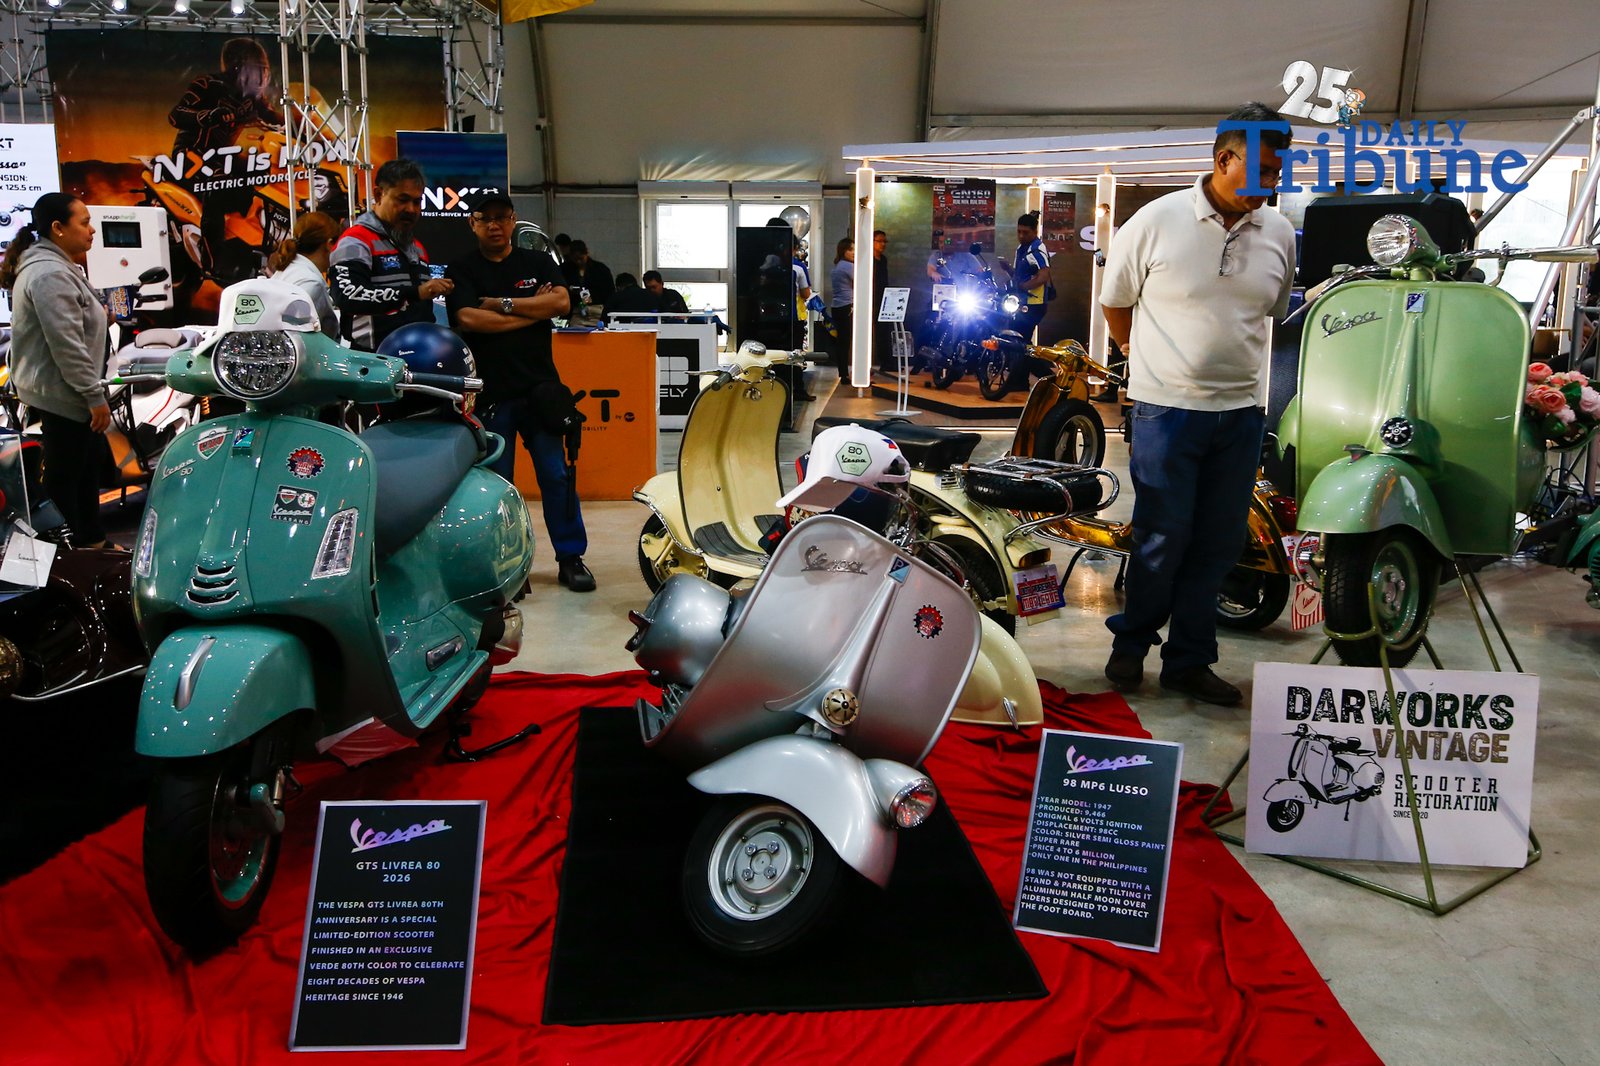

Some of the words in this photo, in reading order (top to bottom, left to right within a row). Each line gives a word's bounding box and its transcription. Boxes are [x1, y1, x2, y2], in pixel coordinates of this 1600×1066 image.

[153, 145, 242, 184] NXT
[247, 146, 271, 172] is
[193, 177, 244, 193] ELECTRIC
[241, 298, 256, 306] 80
[1321, 311, 1384, 339] Vespa
[848, 446, 863, 455] 80
[842, 454, 867, 463] Vespa
[162, 458, 197, 479] Vespa
[272, 503, 313, 516] Vespa
[1285, 686, 1514, 731] DARWORKS
[1372, 728, 1510, 764] VINTAGE
[1066, 745, 1153, 774] Vespa
[1063, 778, 1077, 788] 98
[1080, 780, 1106, 791] MP6
[1109, 784, 1149, 796] LUSSO
[1394, 774, 1498, 794] SCOOTER
[1061, 799, 1091, 808] MODEL:
[1393, 792, 1500, 812] RESTORATION
[1393, 810, 1411, 819] SINCE
[1080, 817, 1104, 826] VOLTS
[1106, 821, 1143, 831] IGNITION
[350, 818, 453, 853] Vespa
[1098, 828, 1119, 836] 98CC
[1060, 839, 1080, 847] RARE
[1065, 831, 1091, 841] SILVER
[1092, 835, 1112, 843] SEMI
[1113, 838, 1140, 847] GLOSS
[1141, 841, 1166, 850] PAINT
[1063, 847, 1073, 855] TO
[1082, 850, 1115, 860] MILLION
[356, 862, 378, 870] GTS
[382, 861, 422, 870] LIVREA
[427, 861, 440, 870] 80
[1053, 854, 1070, 863] ONE
[1082, 858, 1097, 866] THE
[1099, 861, 1148, 873] PHILIPPINES
[383, 874, 411, 882] 2026
[1026, 866, 1036, 875] 98
[1038, 869, 1055, 878] WAS
[1057, 872, 1075, 880] NOT
[1076, 875, 1119, 886] EQUIPPED
[1120, 881, 1142, 890] WITH
[1025, 875, 1052, 886] STAND
[1061, 881, 1094, 892] PARKED
[1096, 886, 1107, 894] BY
[1109, 888, 1141, 899] TILTING
[1023, 883, 1068, 897] ALUMINUM
[1070, 892, 1092, 901] HALF
[1094, 895, 1121, 905] MOON
[1123, 899, 1146, 909] OVER
[367, 901, 384, 909] GTS
[1021, 901, 1036, 910] THE
[1038, 904, 1061, 914] FOOT
[1062, 908, 1094, 919] BOARD.
[1022, 892, 1051, 903] RIDERS
[1053, 898, 1095, 910] DESIGNED
[1097, 904, 1108, 912] TO
[1110, 906, 1149, 918] PROTECT
[316, 916, 379, 924] ANNIVERSARY
[314, 931, 391, 939] LIMITED-EDITION
[384, 946, 432, 954] EXCLUSIVE
[414, 961, 464, 969] CELEBRATE
[308, 978, 335, 986] EIGHT
[382, 977, 395, 985] OF
[397, 977, 425, 985] VESPA
[352, 993, 379, 1001] SINCE
